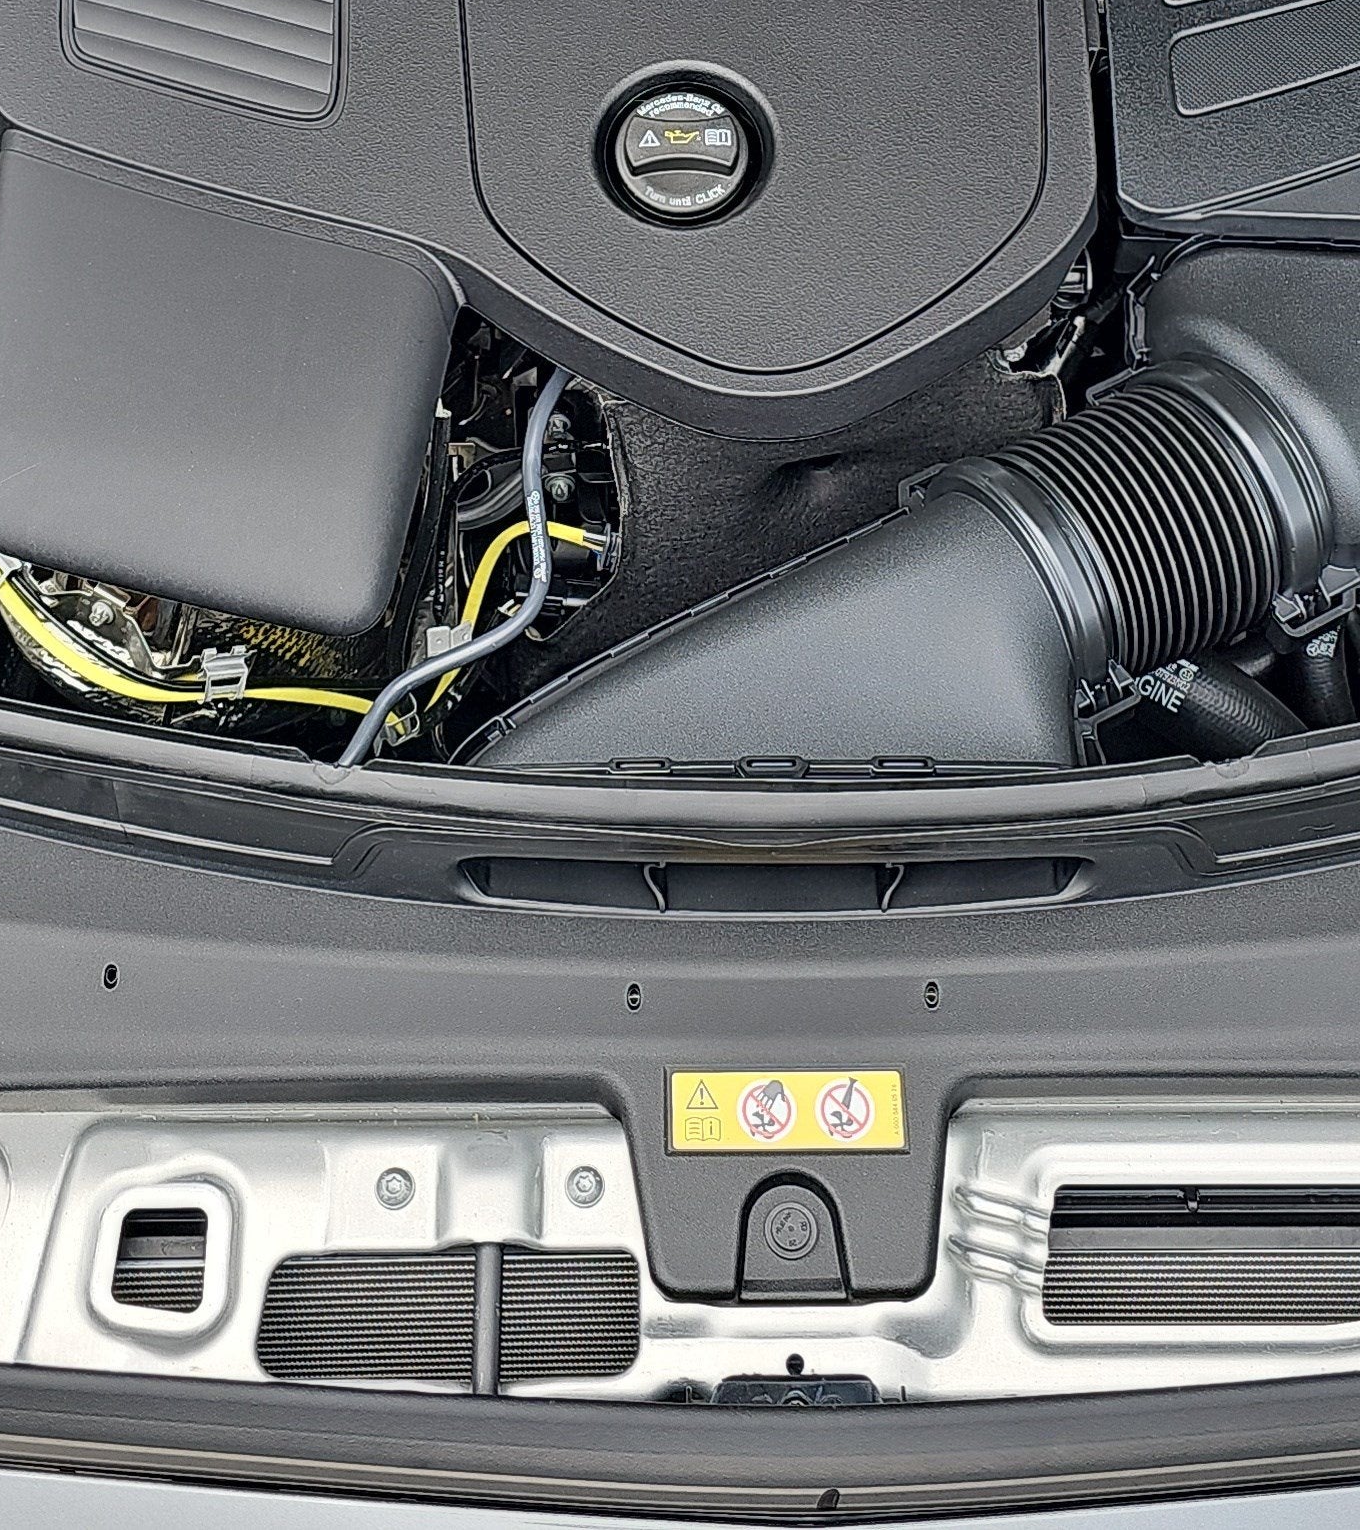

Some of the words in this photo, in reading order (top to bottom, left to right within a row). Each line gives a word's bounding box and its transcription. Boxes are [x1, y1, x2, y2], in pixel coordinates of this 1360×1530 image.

[636, 93, 710, 118] Mercedes-Benz
[649, 103, 714, 118] recommended
[644, 186, 666, 203] Turn
[669, 195, 692, 207] until
[695, 184, 726, 204] CLICK
